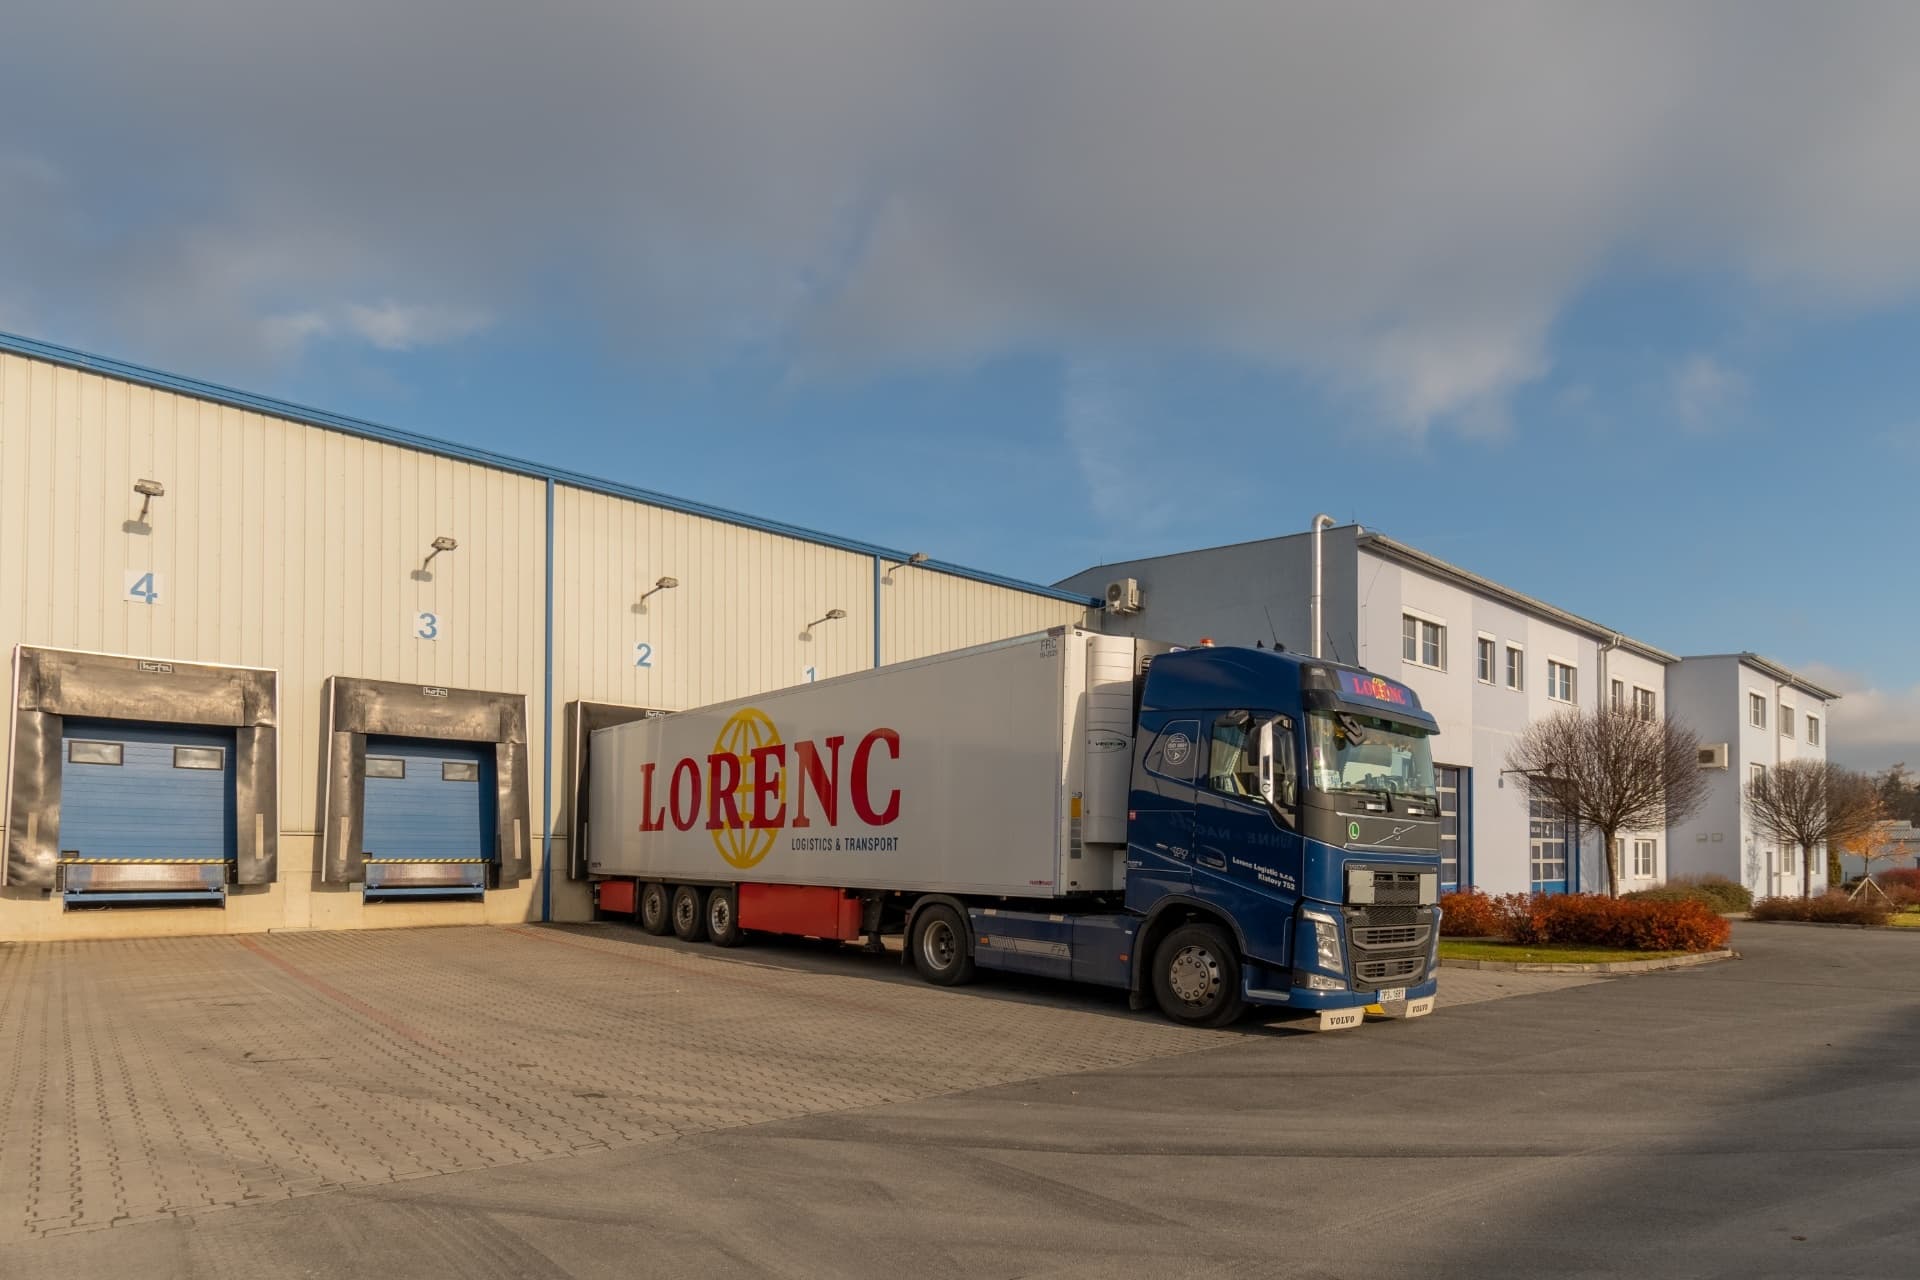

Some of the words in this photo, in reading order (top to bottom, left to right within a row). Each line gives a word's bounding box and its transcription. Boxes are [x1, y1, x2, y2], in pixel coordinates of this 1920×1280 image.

[130, 572, 158, 605] 4
[418, 612, 437, 639] 3
[636, 643, 652, 668] 2
[806, 666, 815, 683] 1
[639, 728, 901, 832] LORENC
[791, 838, 833, 851] LOGISTICS
[835, 838, 841, 851] &
[844, 837, 898, 851] TRANSPORT
[1412, 1003, 1428, 1013] VOLVO
[1330, 1015, 1355, 1025] VOLVO
